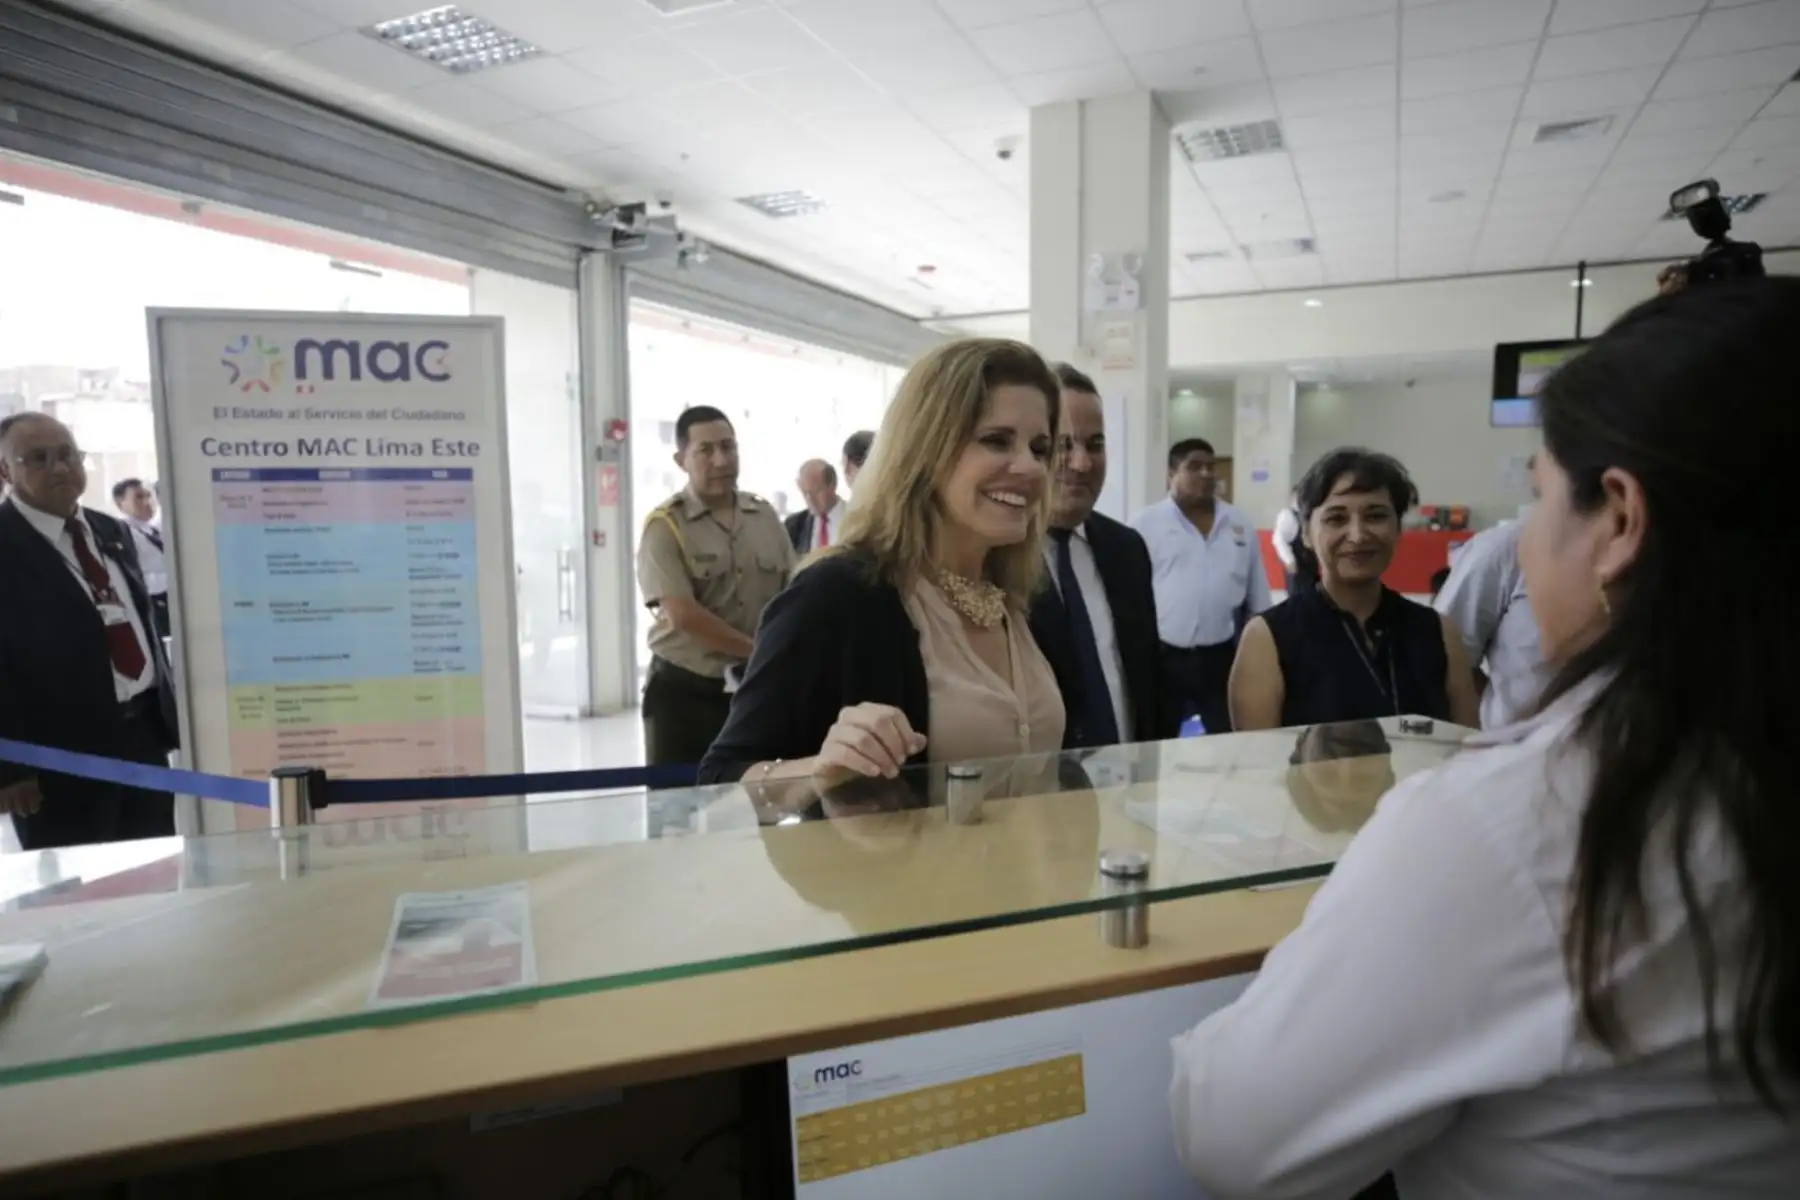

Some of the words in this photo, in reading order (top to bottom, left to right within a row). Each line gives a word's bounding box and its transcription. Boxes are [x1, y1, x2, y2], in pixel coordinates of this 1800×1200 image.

[294, 338, 452, 382] mac
[213, 406, 228, 420] El
[232, 406, 284, 420] Estado
[287, 407, 300, 420] al
[304, 406, 363, 421] Servicio
[366, 407, 387, 421] del
[391, 406, 466, 422] Ciudadano
[200, 436, 289, 458] Centro
[297, 437, 358, 457] MAC
[366, 437, 424, 458] Lima
[432, 438, 481, 458] Este
[814, 1059, 863, 1083] mac
